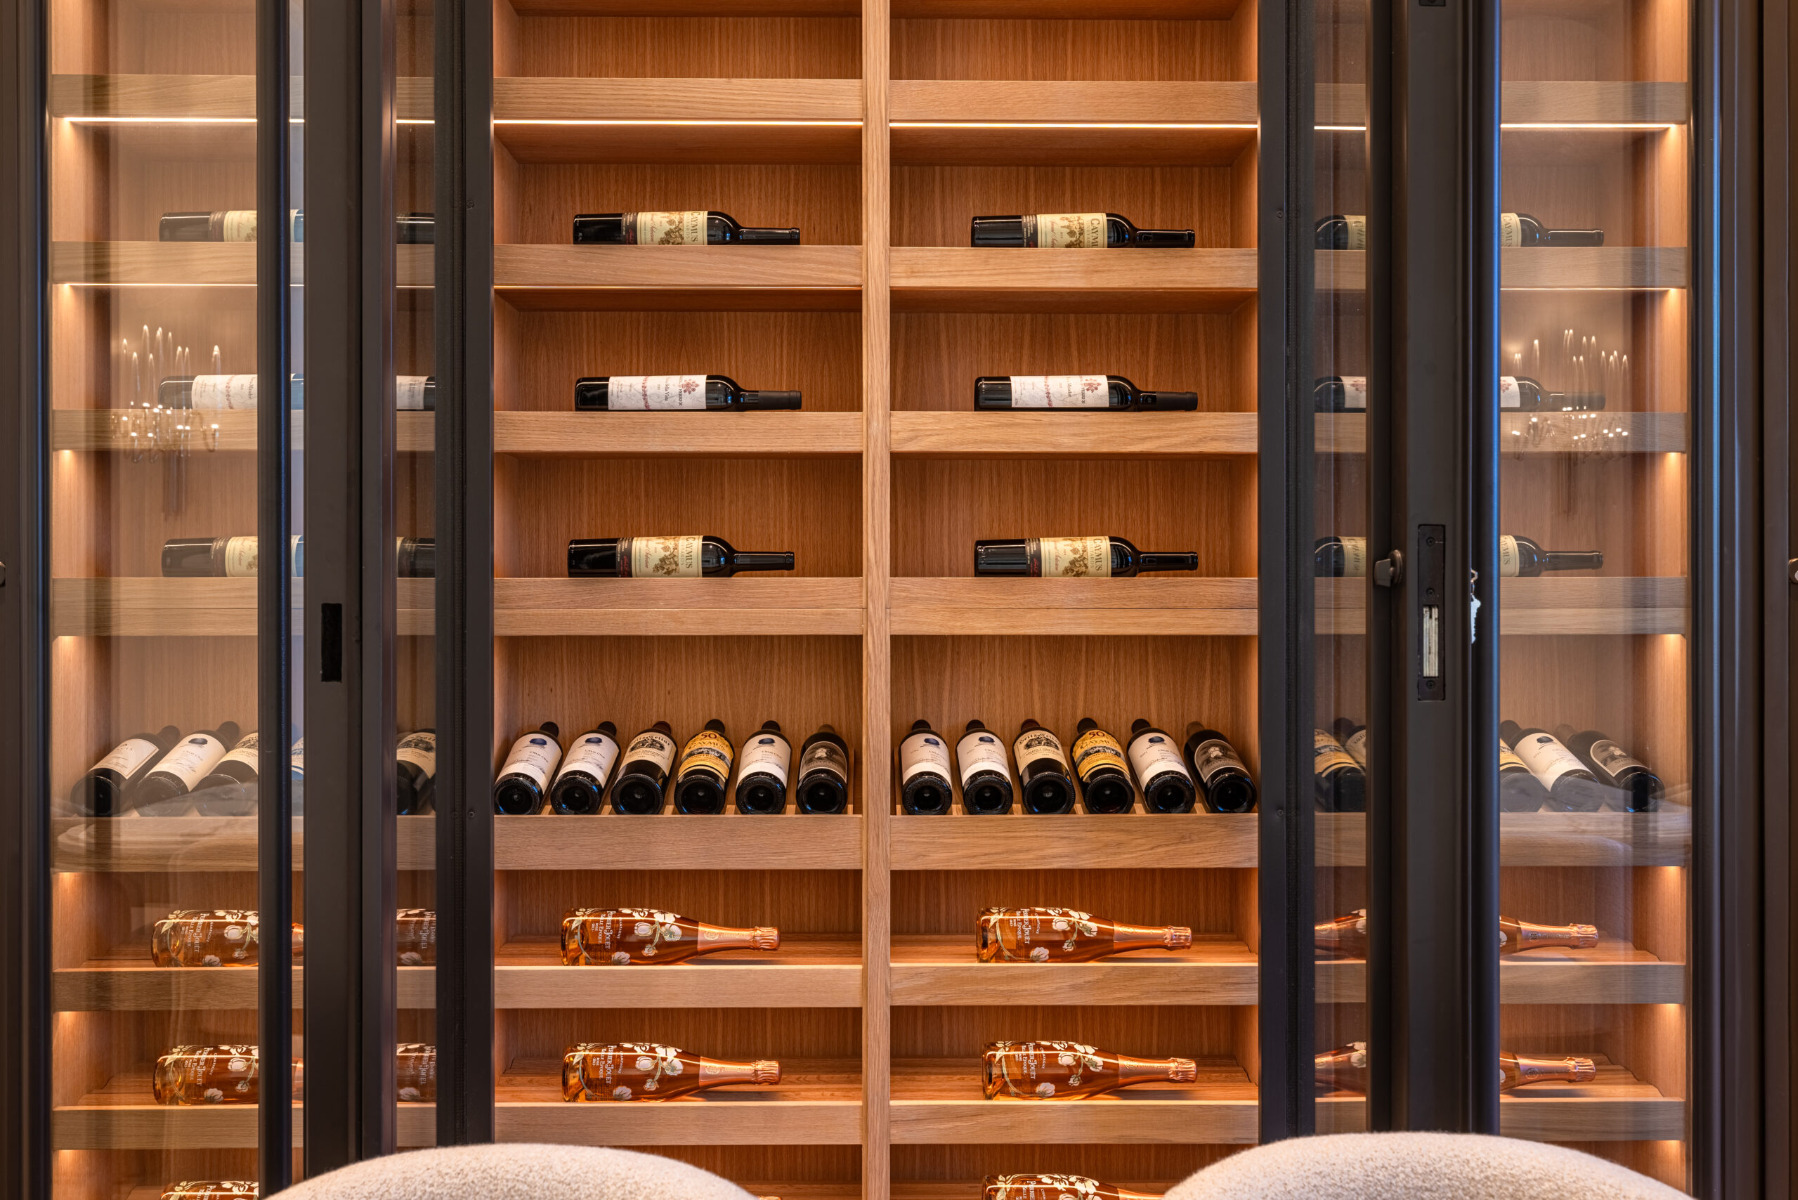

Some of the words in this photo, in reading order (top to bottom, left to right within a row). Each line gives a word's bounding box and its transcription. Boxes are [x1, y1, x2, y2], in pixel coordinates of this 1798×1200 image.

[690, 211, 701, 243] CAYMUS
[685, 536, 696, 569] CAYMUS
[1093, 538, 1103, 571] CAYMUS
[701, 732, 717, 740] 50
[1088, 731, 1105, 740] 50
